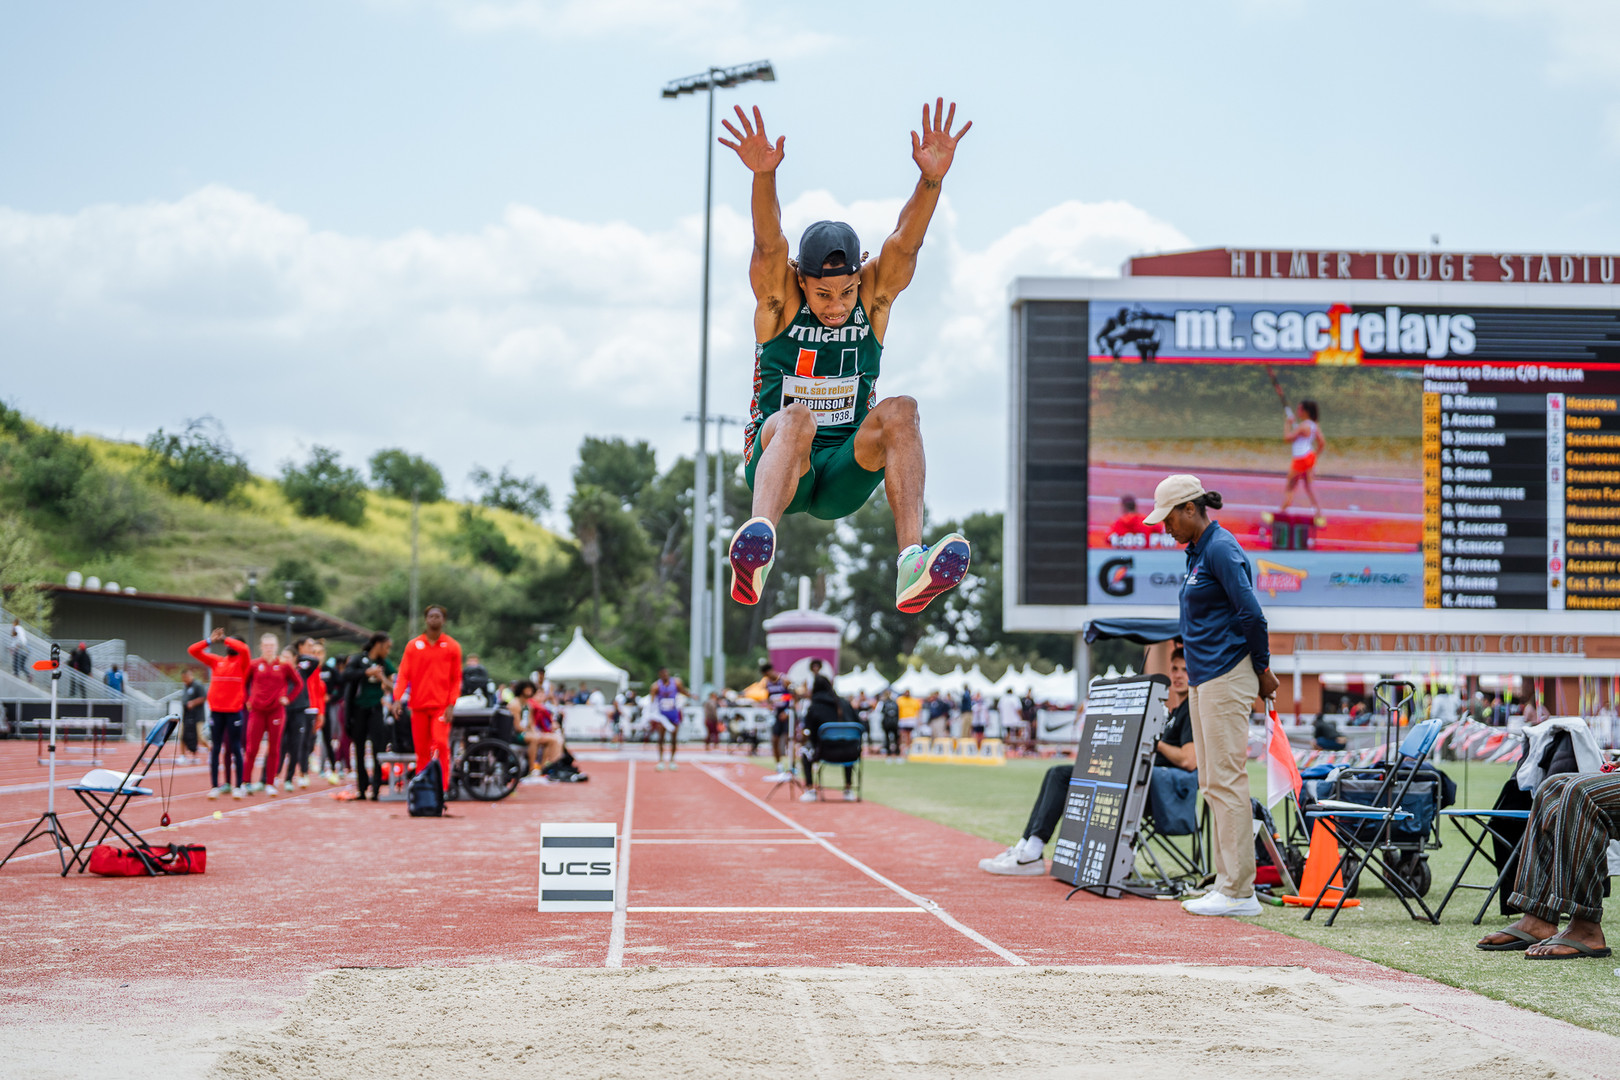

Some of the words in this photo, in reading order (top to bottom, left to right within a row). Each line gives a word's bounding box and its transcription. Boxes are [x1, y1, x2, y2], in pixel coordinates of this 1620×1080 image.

[1230, 249, 1351, 279] HILMER
[1375, 251, 1475, 281] LODGE
[1174, 305, 1246, 352] mt.
[1252, 310, 1332, 353] sac
[1340, 306, 1477, 358] relays
[794, 385, 809, 395] mt.
[810, 387, 827, 395] sac
[828, 385, 854, 395] relays
[831, 411, 850, 422] 1938
[1566, 414, 1602, 429] IDAHO
[1098, 556, 1134, 597] G
[1341, 634, 1382, 651] SAN
[1394, 634, 1487, 652] ANTONIO
[1500, 634, 1586, 654] COLLEGE
[542, 862, 611, 876] UCS
